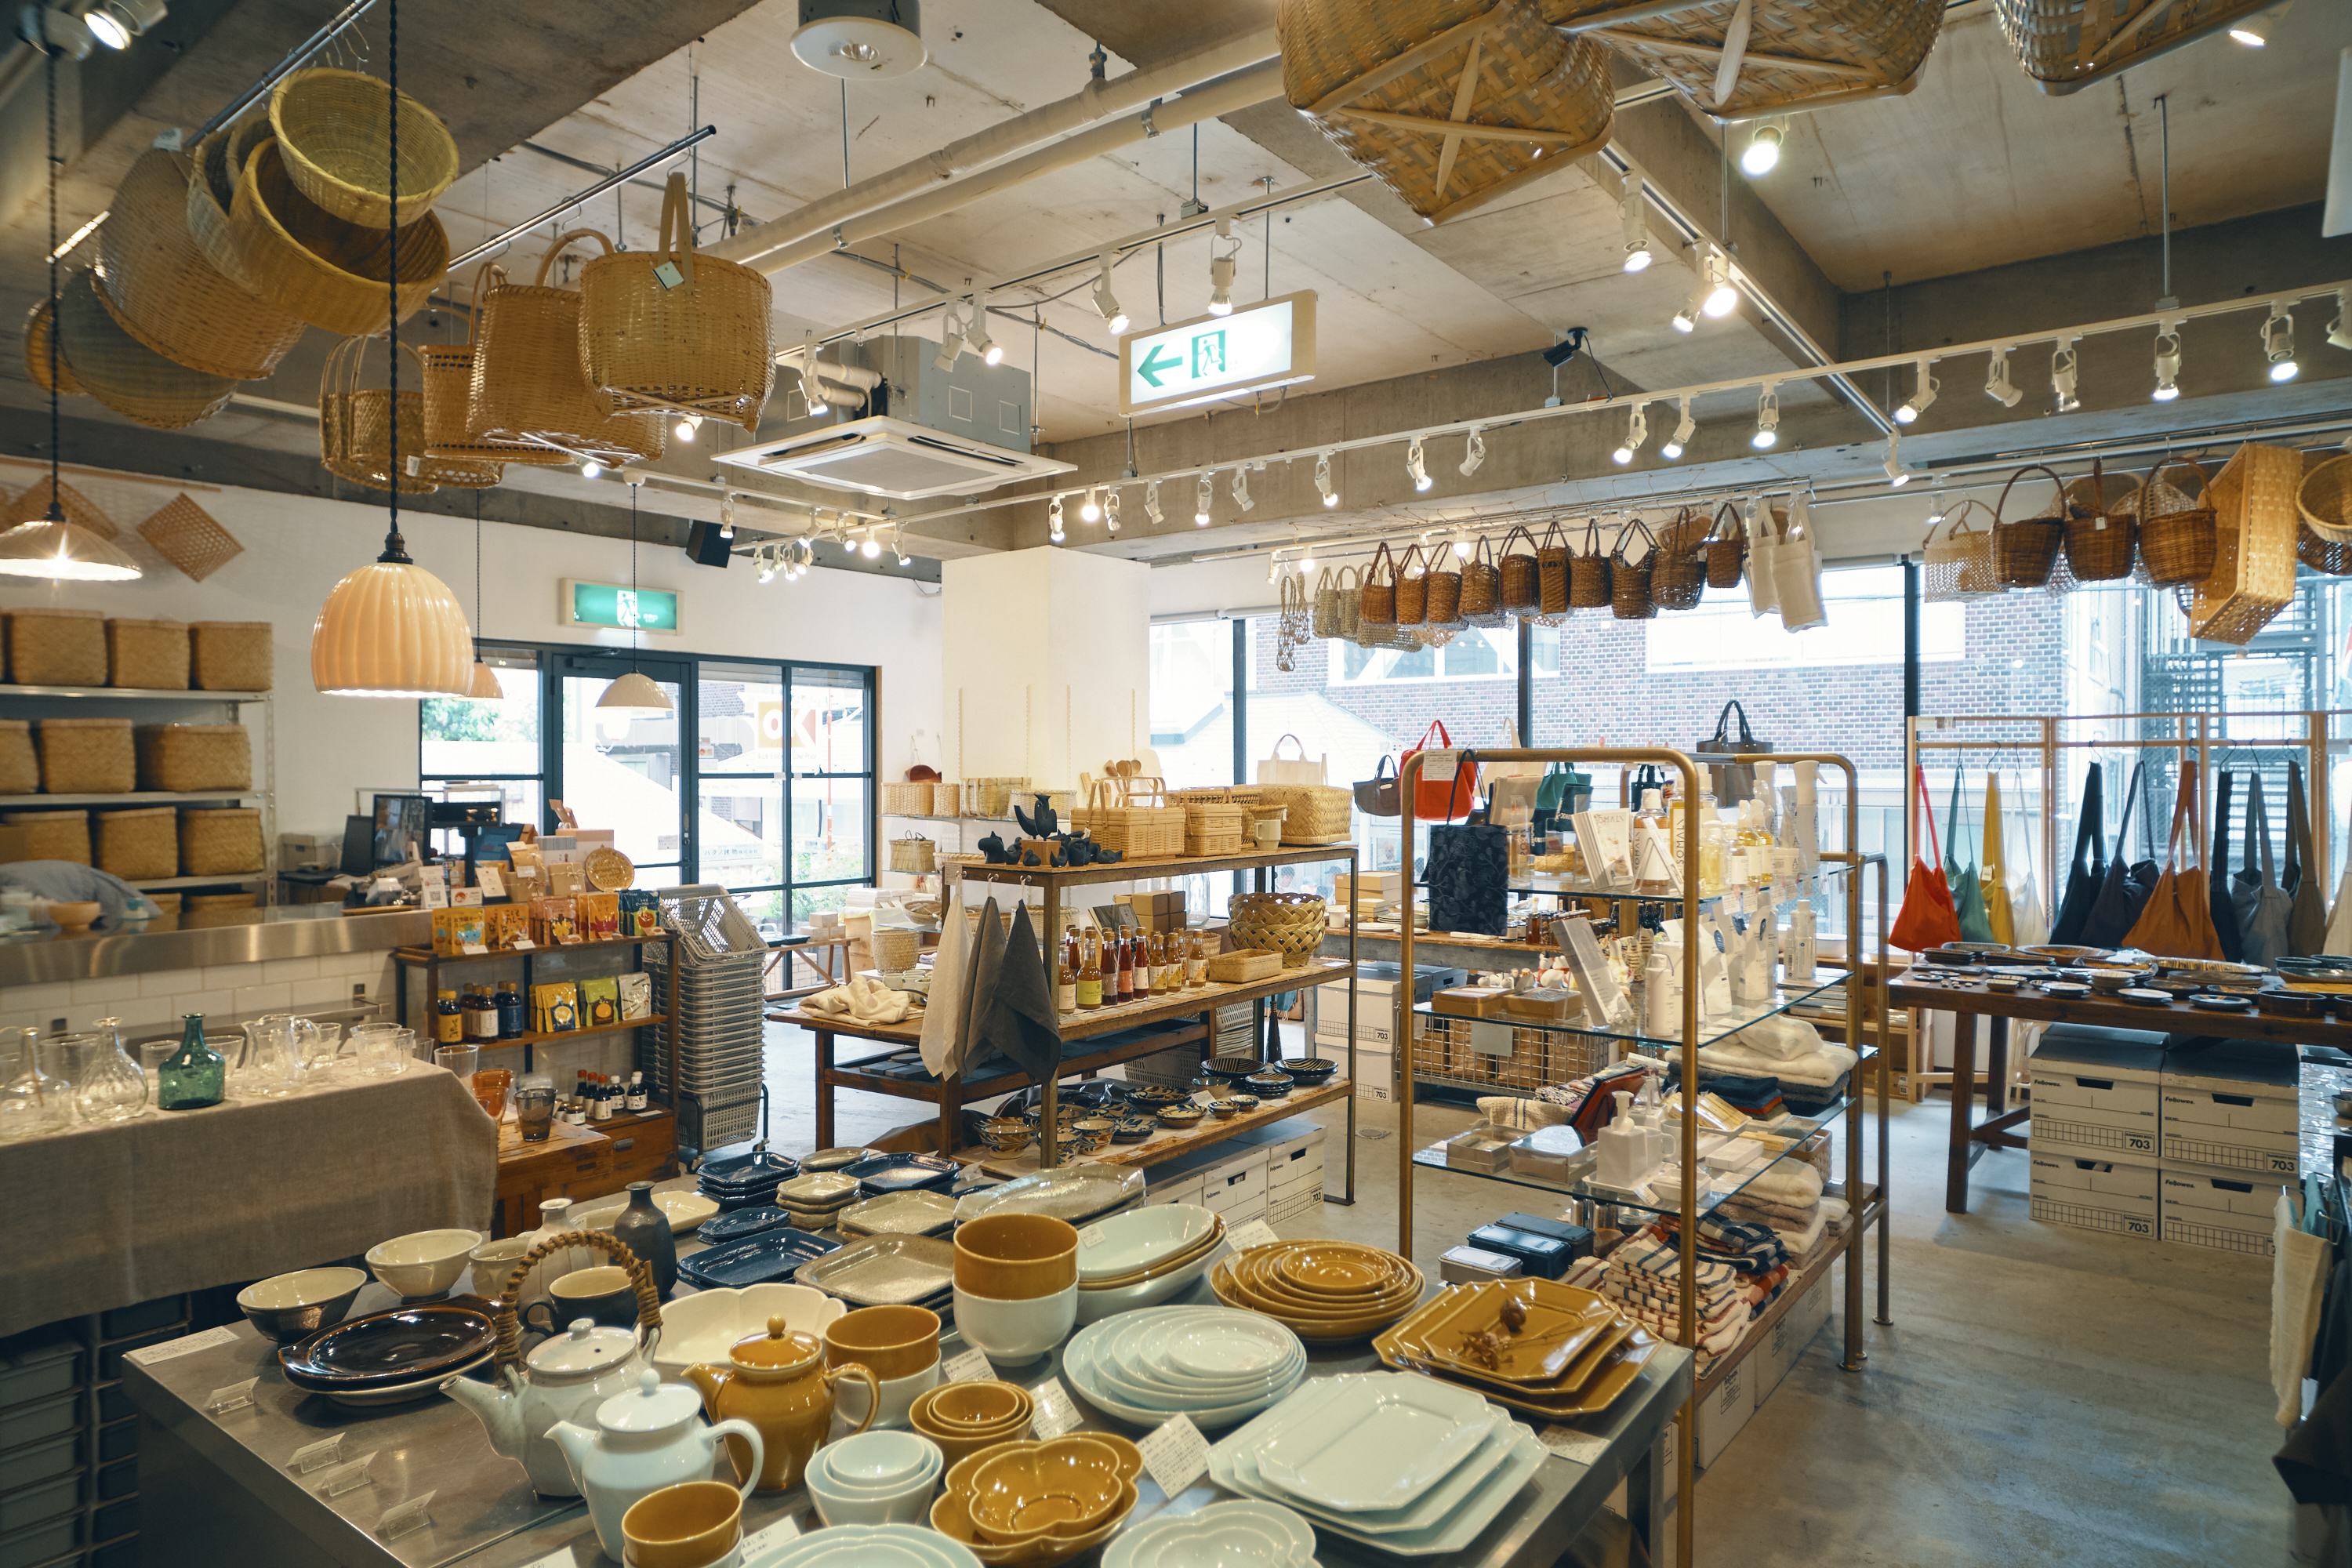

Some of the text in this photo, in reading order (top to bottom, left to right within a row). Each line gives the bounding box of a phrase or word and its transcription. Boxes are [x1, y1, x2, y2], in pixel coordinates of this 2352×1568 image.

[1376, 1091, 1387, 1099] 703
[2129, 1138, 2151, 1150] 703
[2271, 1160, 2295, 1172] 703
[1312, 1192, 1321, 1203] 703
[2129, 1221, 2150, 1233] 703
